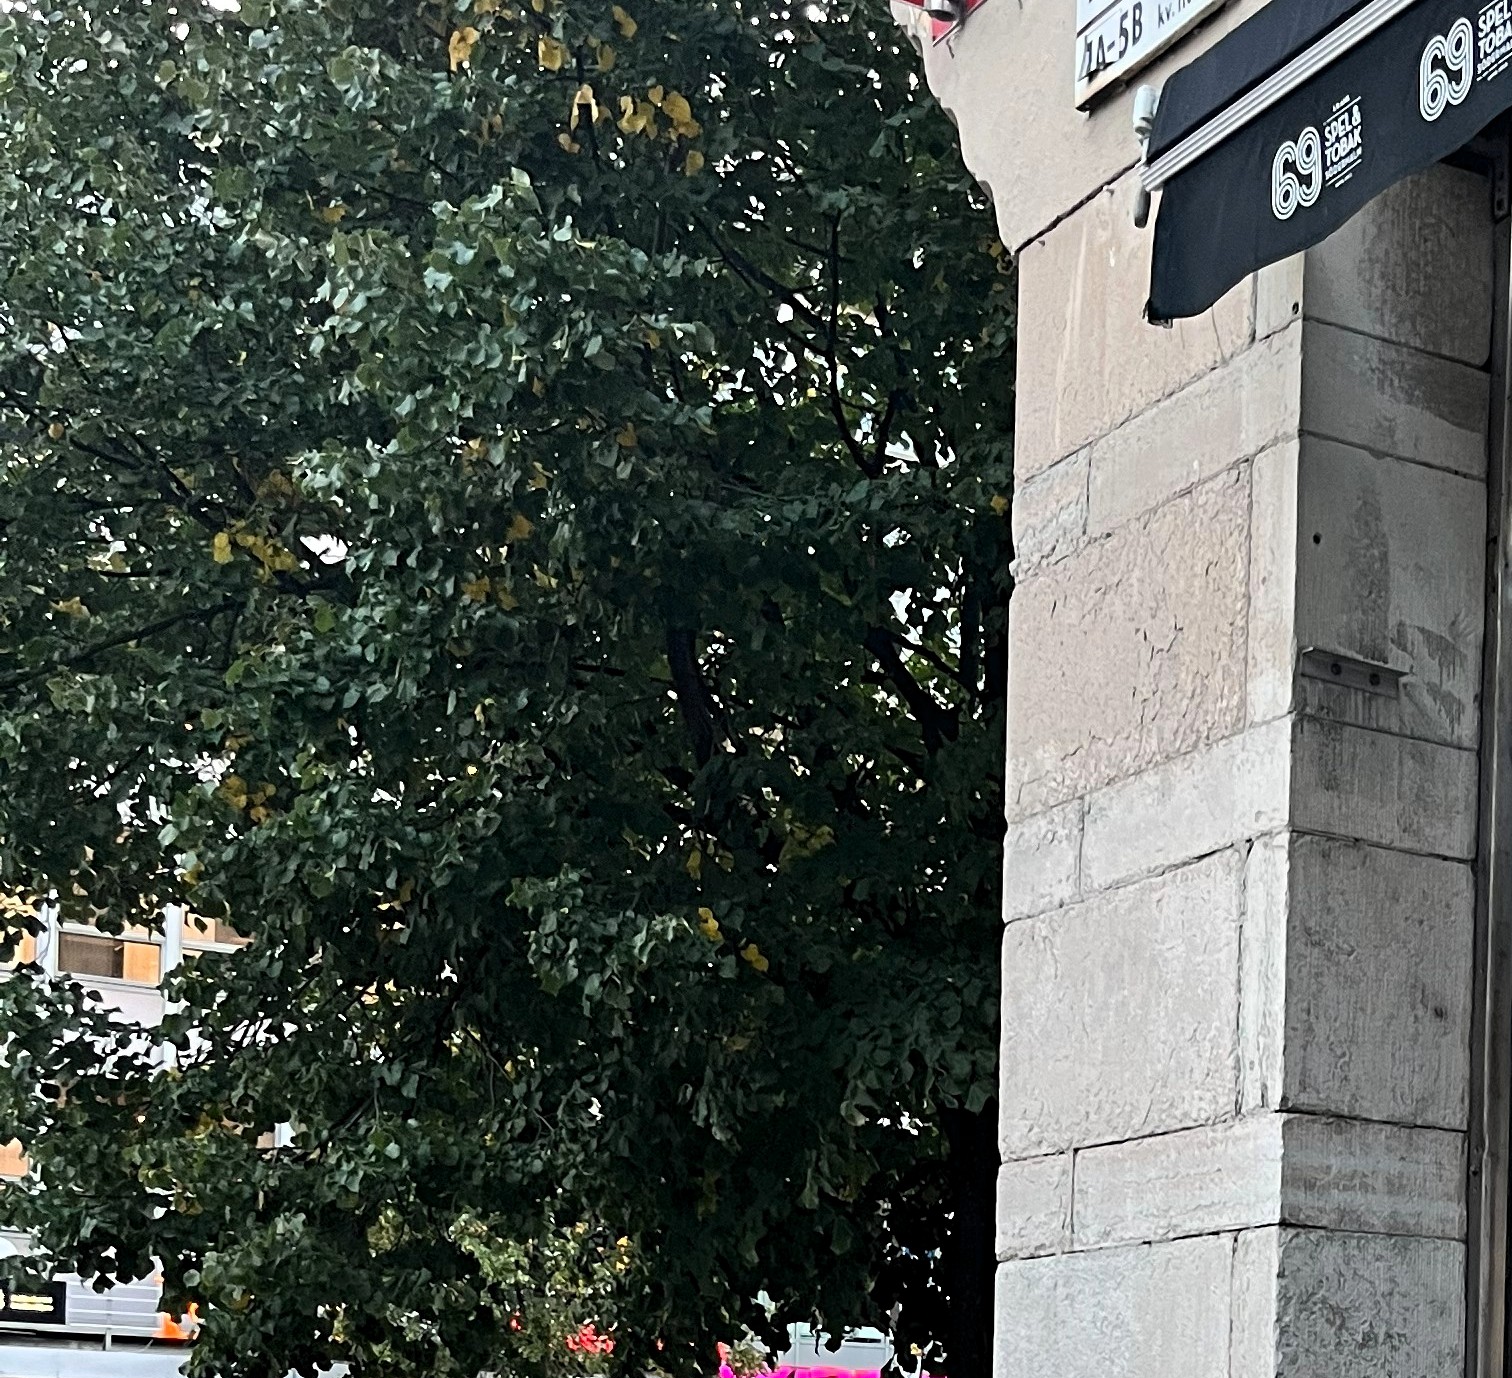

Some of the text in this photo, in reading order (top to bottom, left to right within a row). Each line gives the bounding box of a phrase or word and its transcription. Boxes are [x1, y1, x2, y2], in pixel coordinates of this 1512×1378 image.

[1420, 17, 1473, 122] 69
[1272, 126, 1322, 220] 69
[1325, 125, 1362, 167] TOBAK
